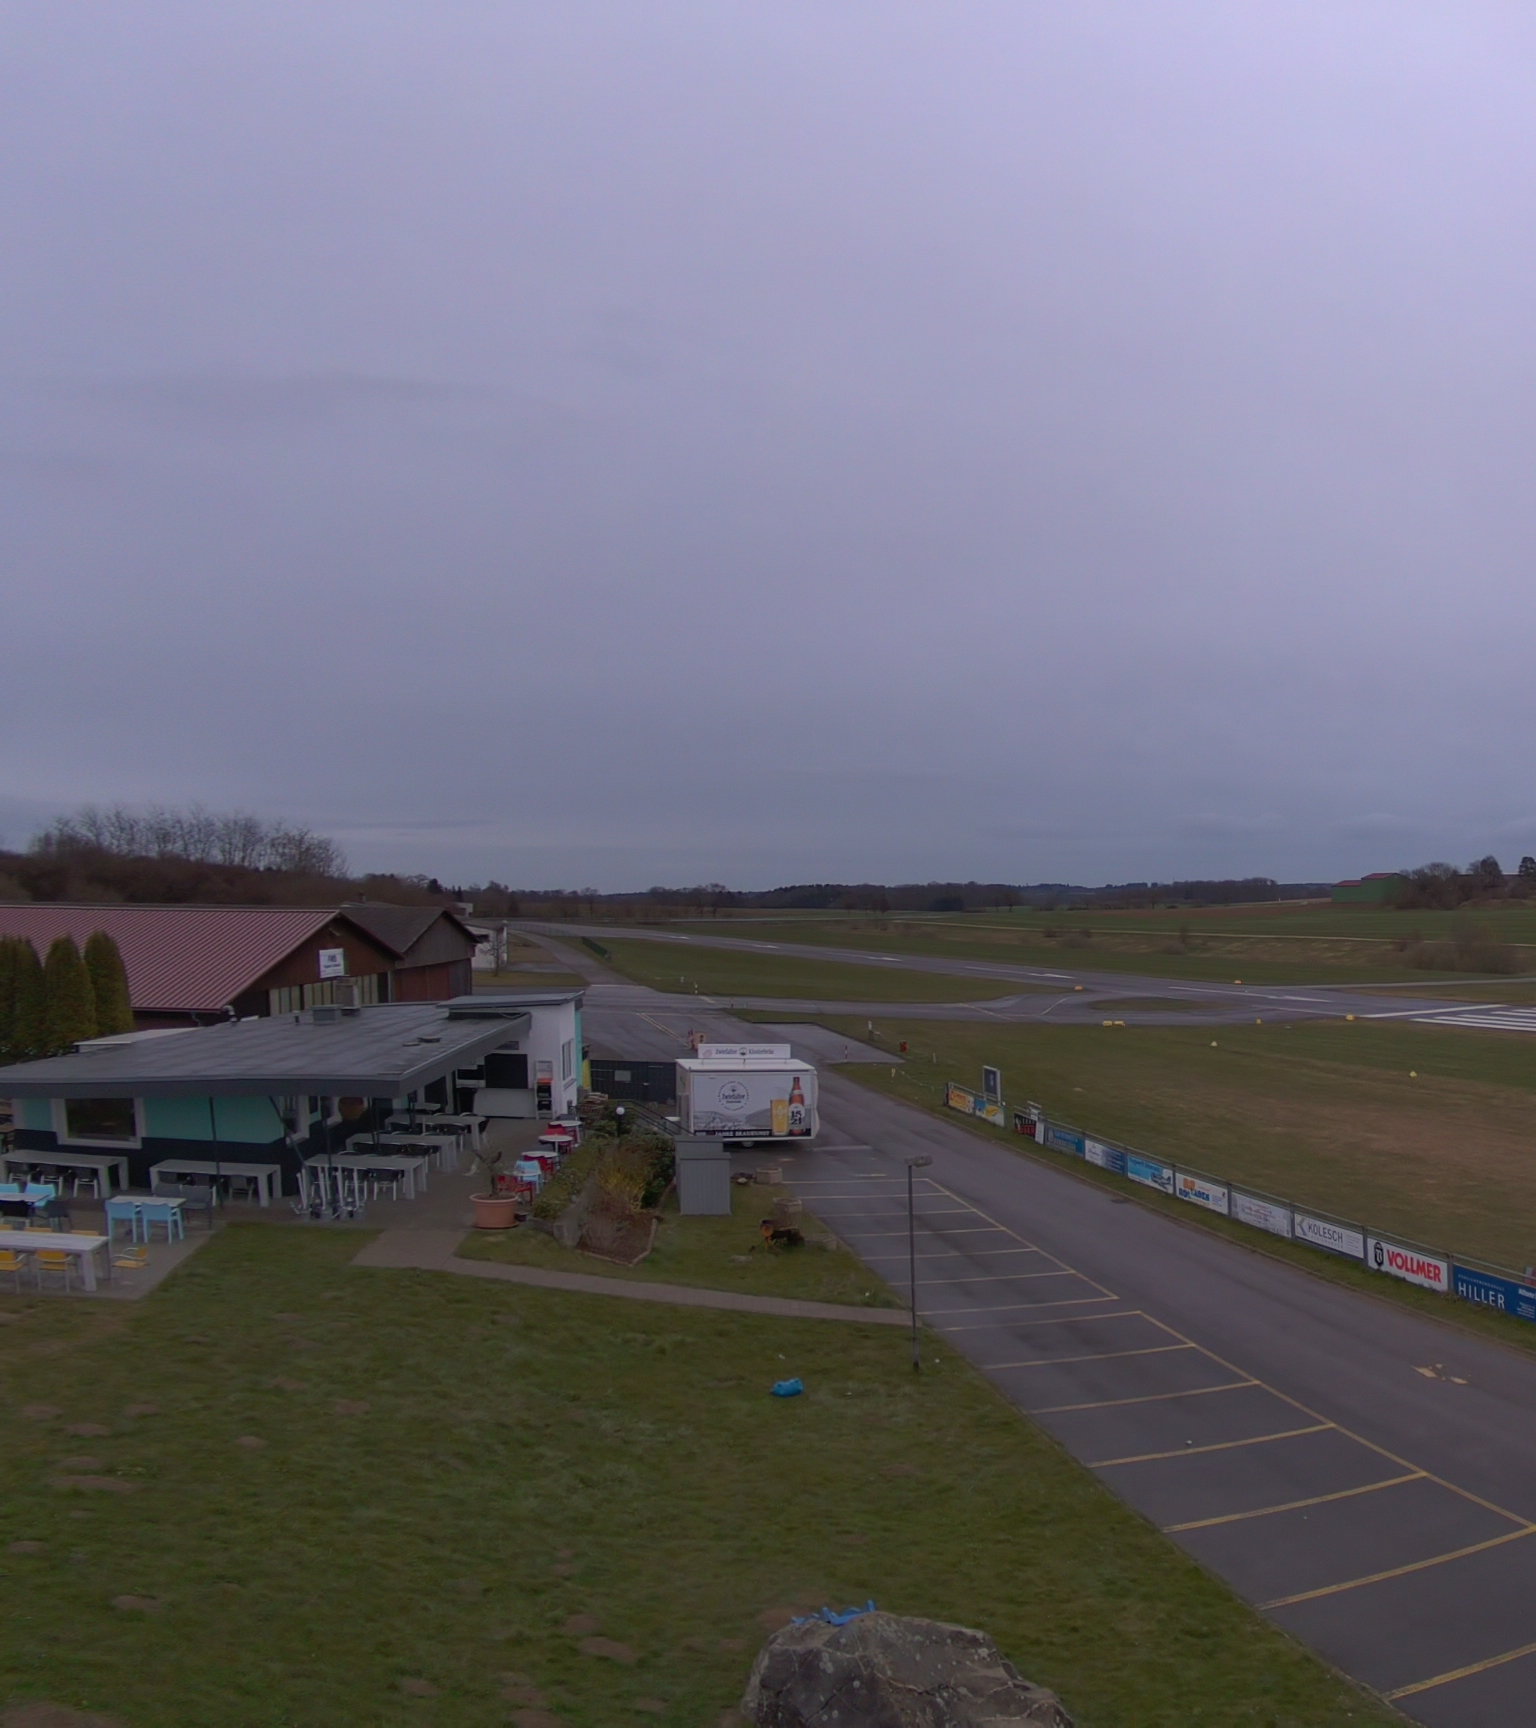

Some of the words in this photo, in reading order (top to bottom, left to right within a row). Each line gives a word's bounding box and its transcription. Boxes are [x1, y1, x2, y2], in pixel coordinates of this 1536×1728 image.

[1308, 1222, 1343, 1243] KOLESCH
[1387, 1249, 1442, 1283] VOLLMER
[1458, 1281, 1505, 1309] HILLER
